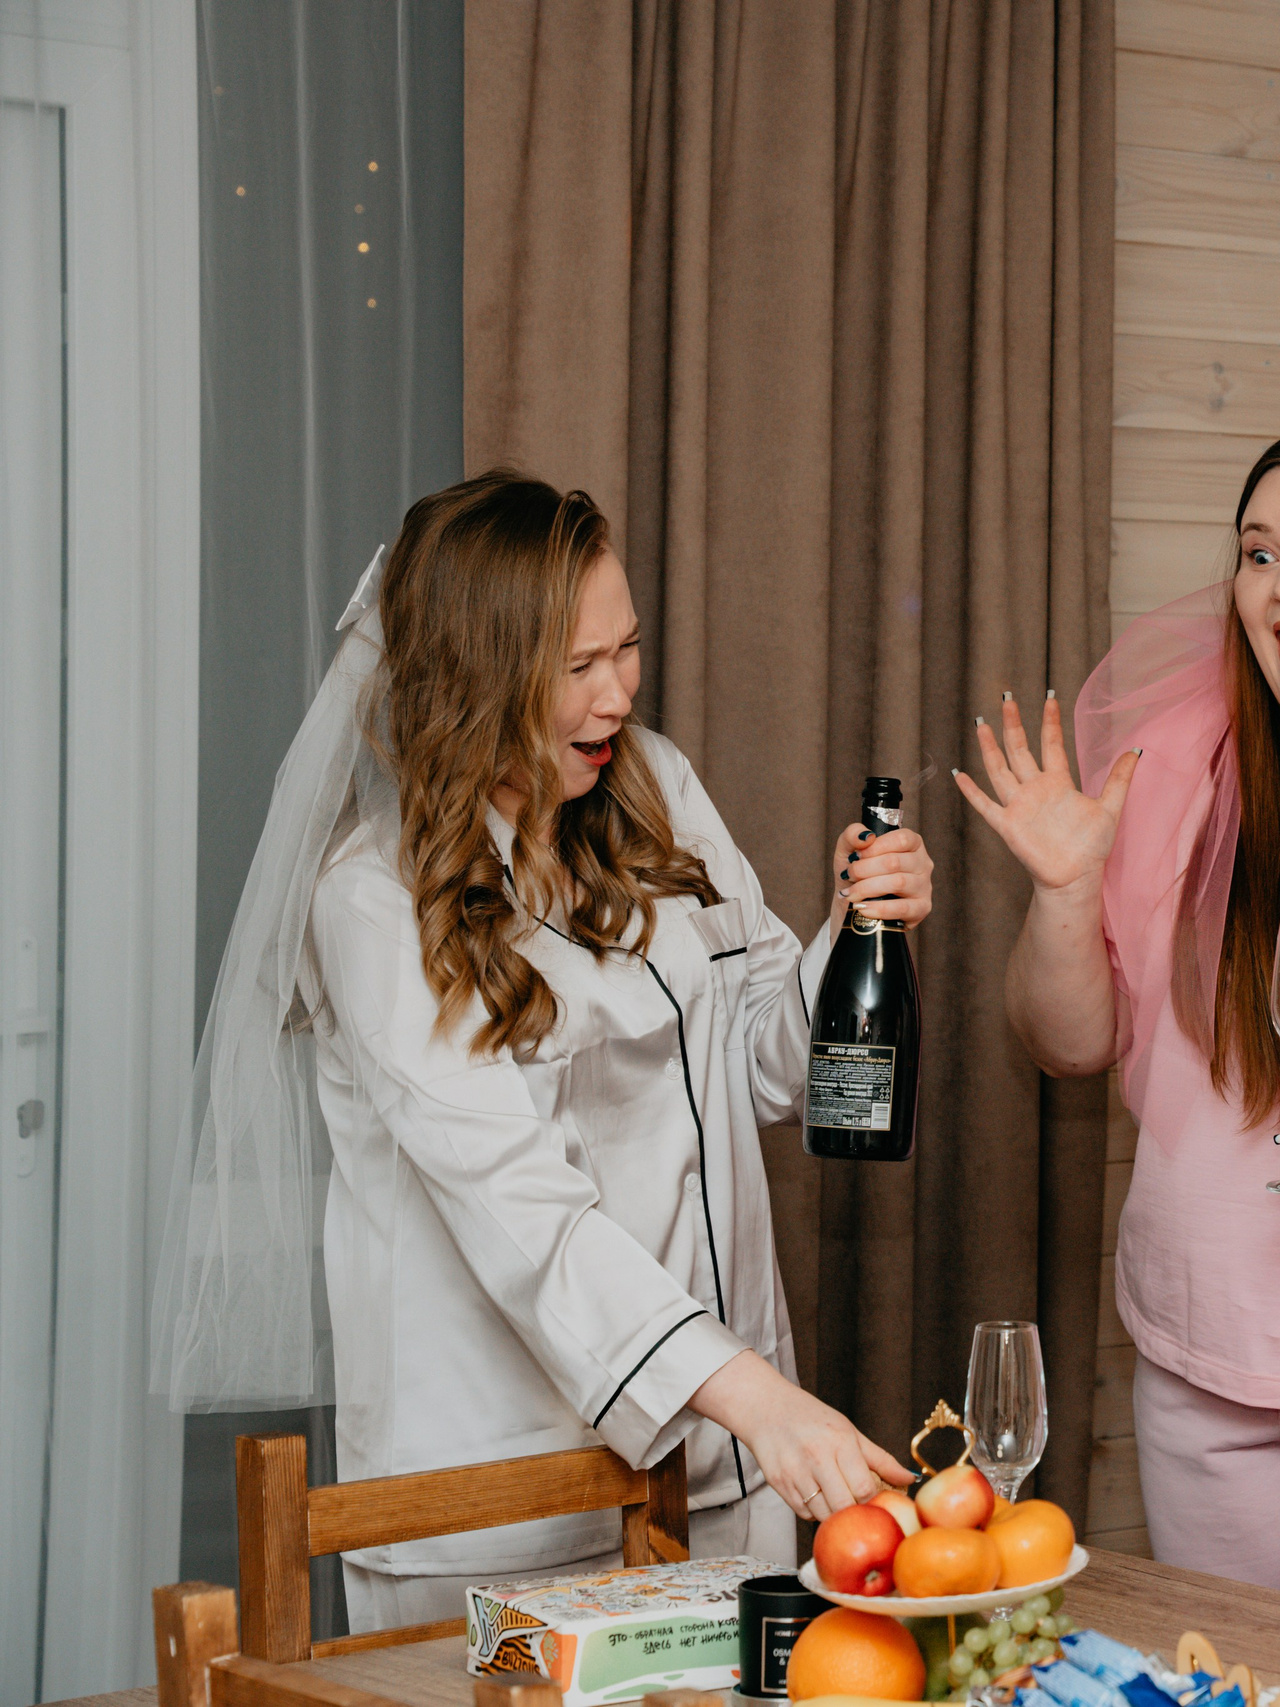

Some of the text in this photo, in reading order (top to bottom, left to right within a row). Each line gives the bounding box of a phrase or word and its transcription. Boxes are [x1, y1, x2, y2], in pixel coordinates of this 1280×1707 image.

[608, 1633, 628, 1647] ЭТО
[634, 1626, 674, 1640] ОБРАТНАЯ
[680, 1620, 715, 1634] СТОРОНА
